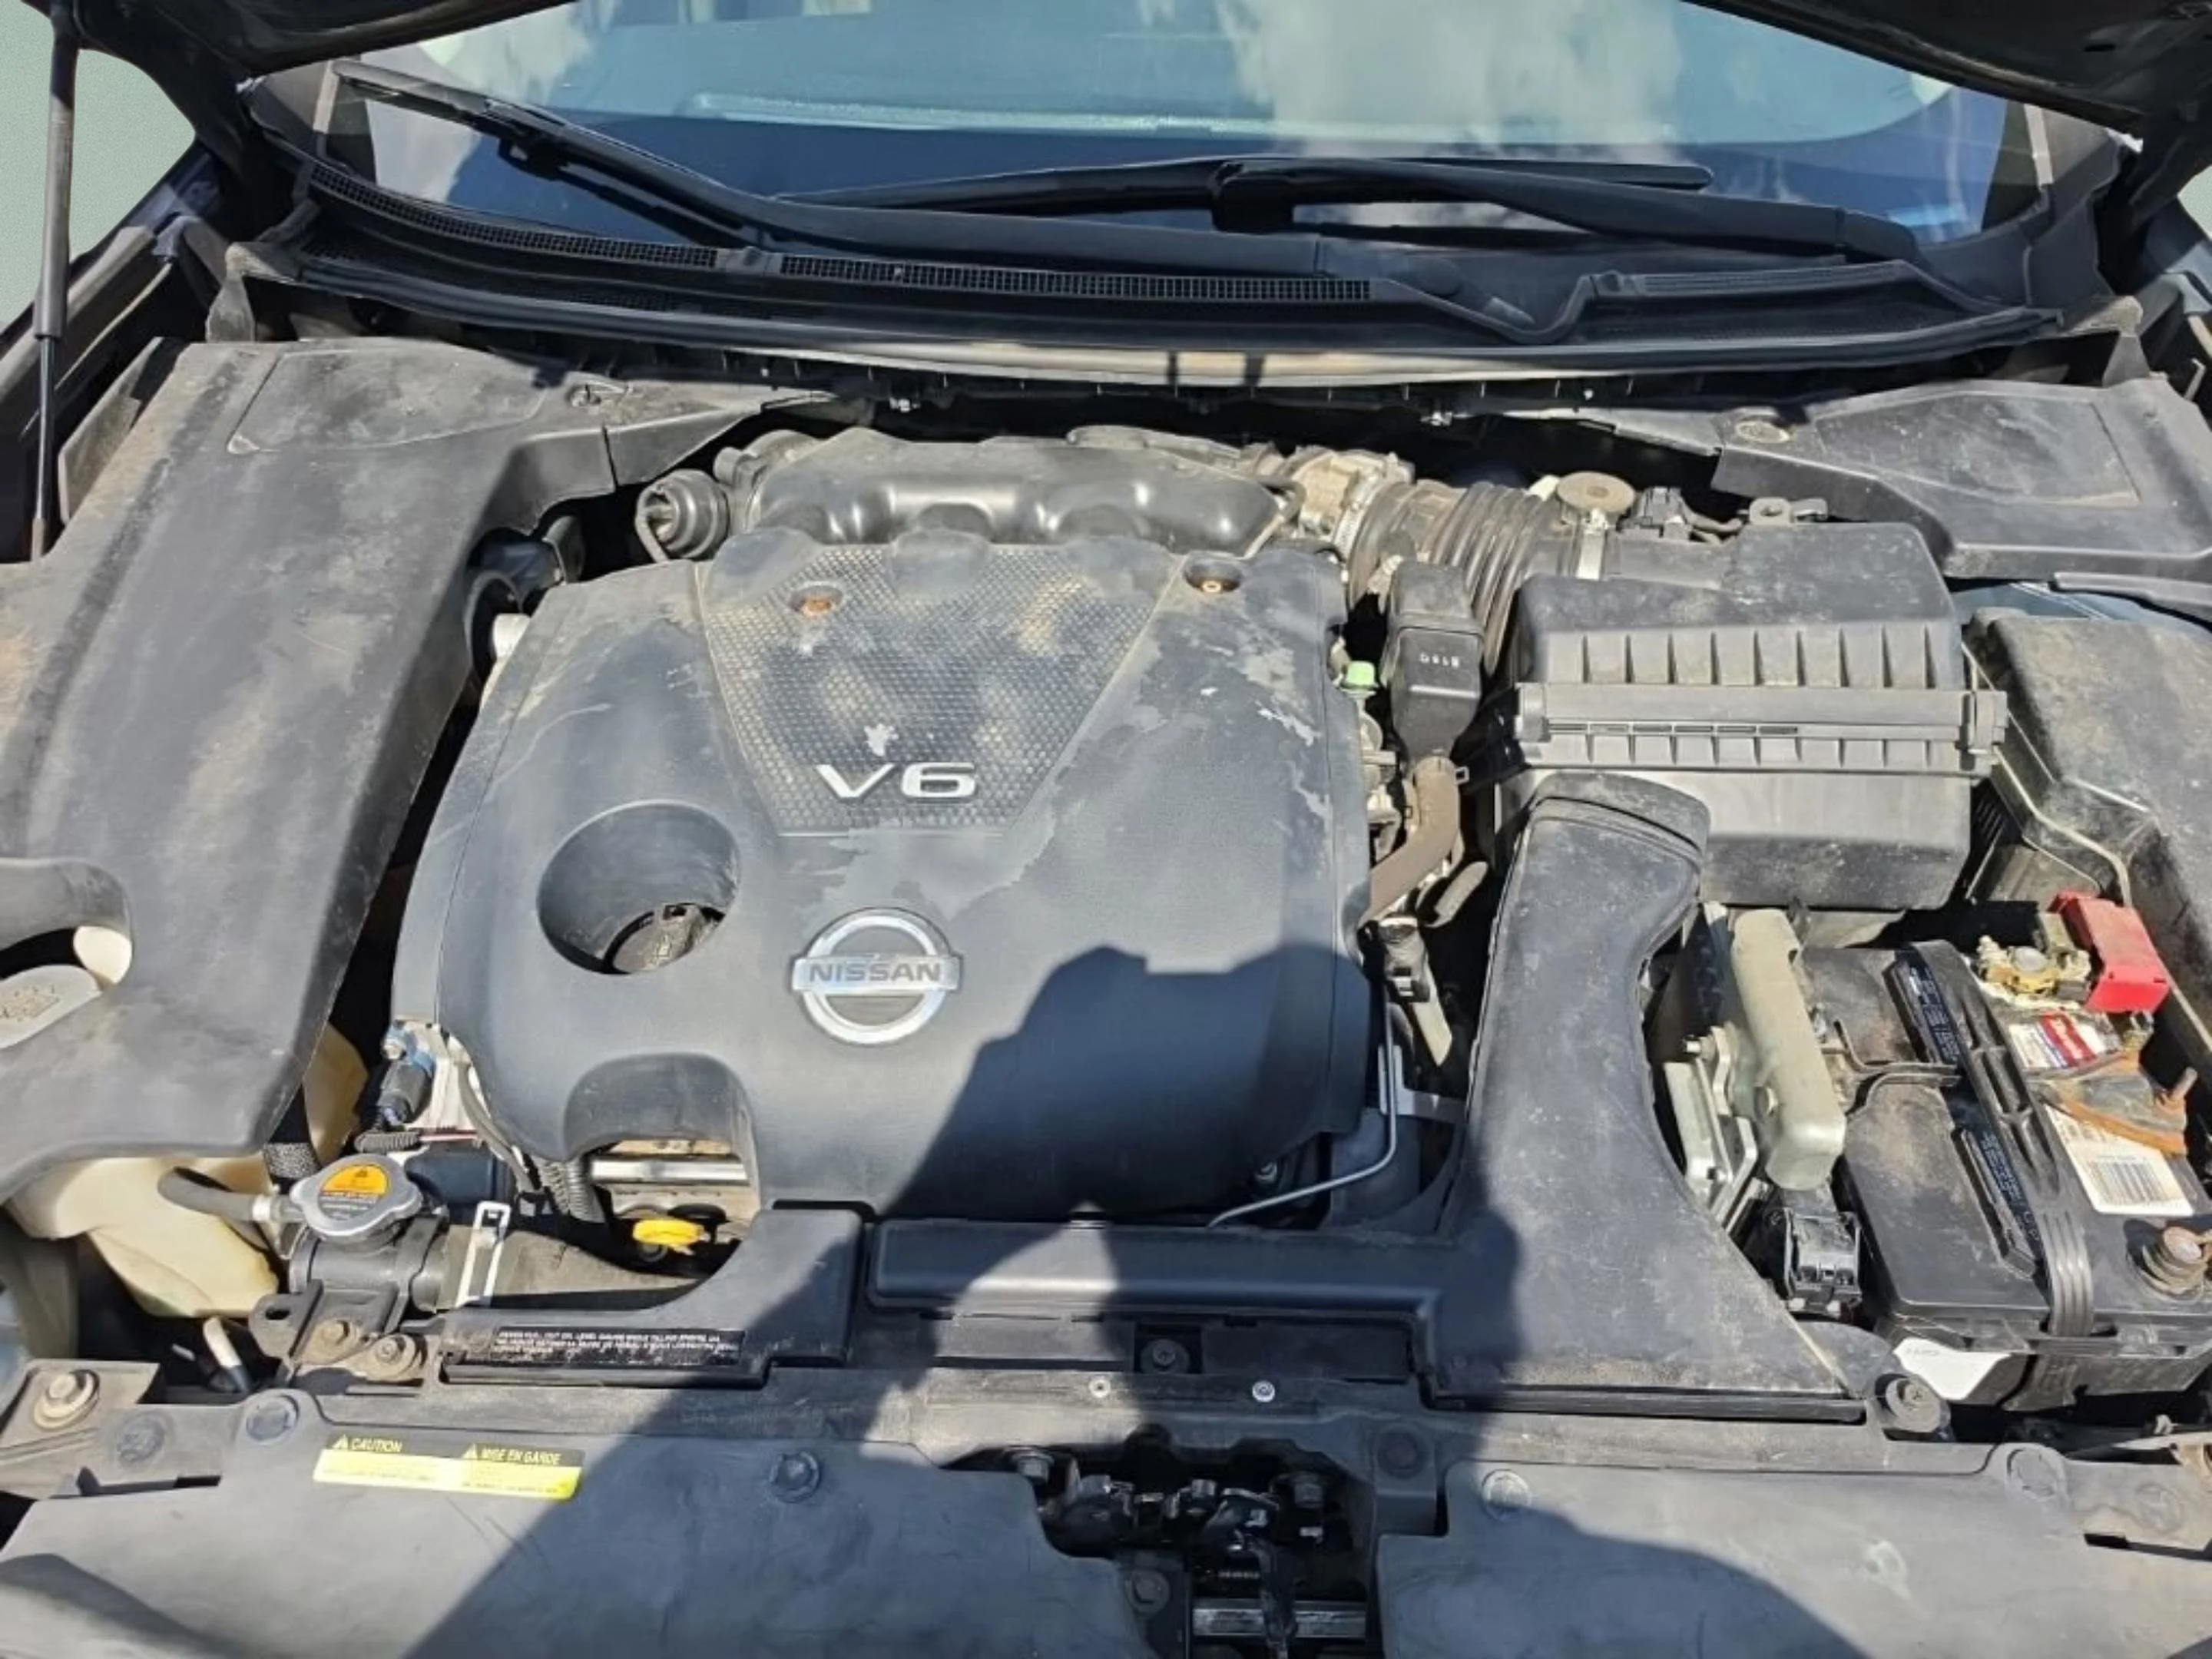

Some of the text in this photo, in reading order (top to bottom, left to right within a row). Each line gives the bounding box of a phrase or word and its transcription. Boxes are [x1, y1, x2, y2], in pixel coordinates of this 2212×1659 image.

[815, 762, 977, 799] V6
[809, 962, 942, 983] NISSAN
[351, 1437, 402, 1454] CAUTION
